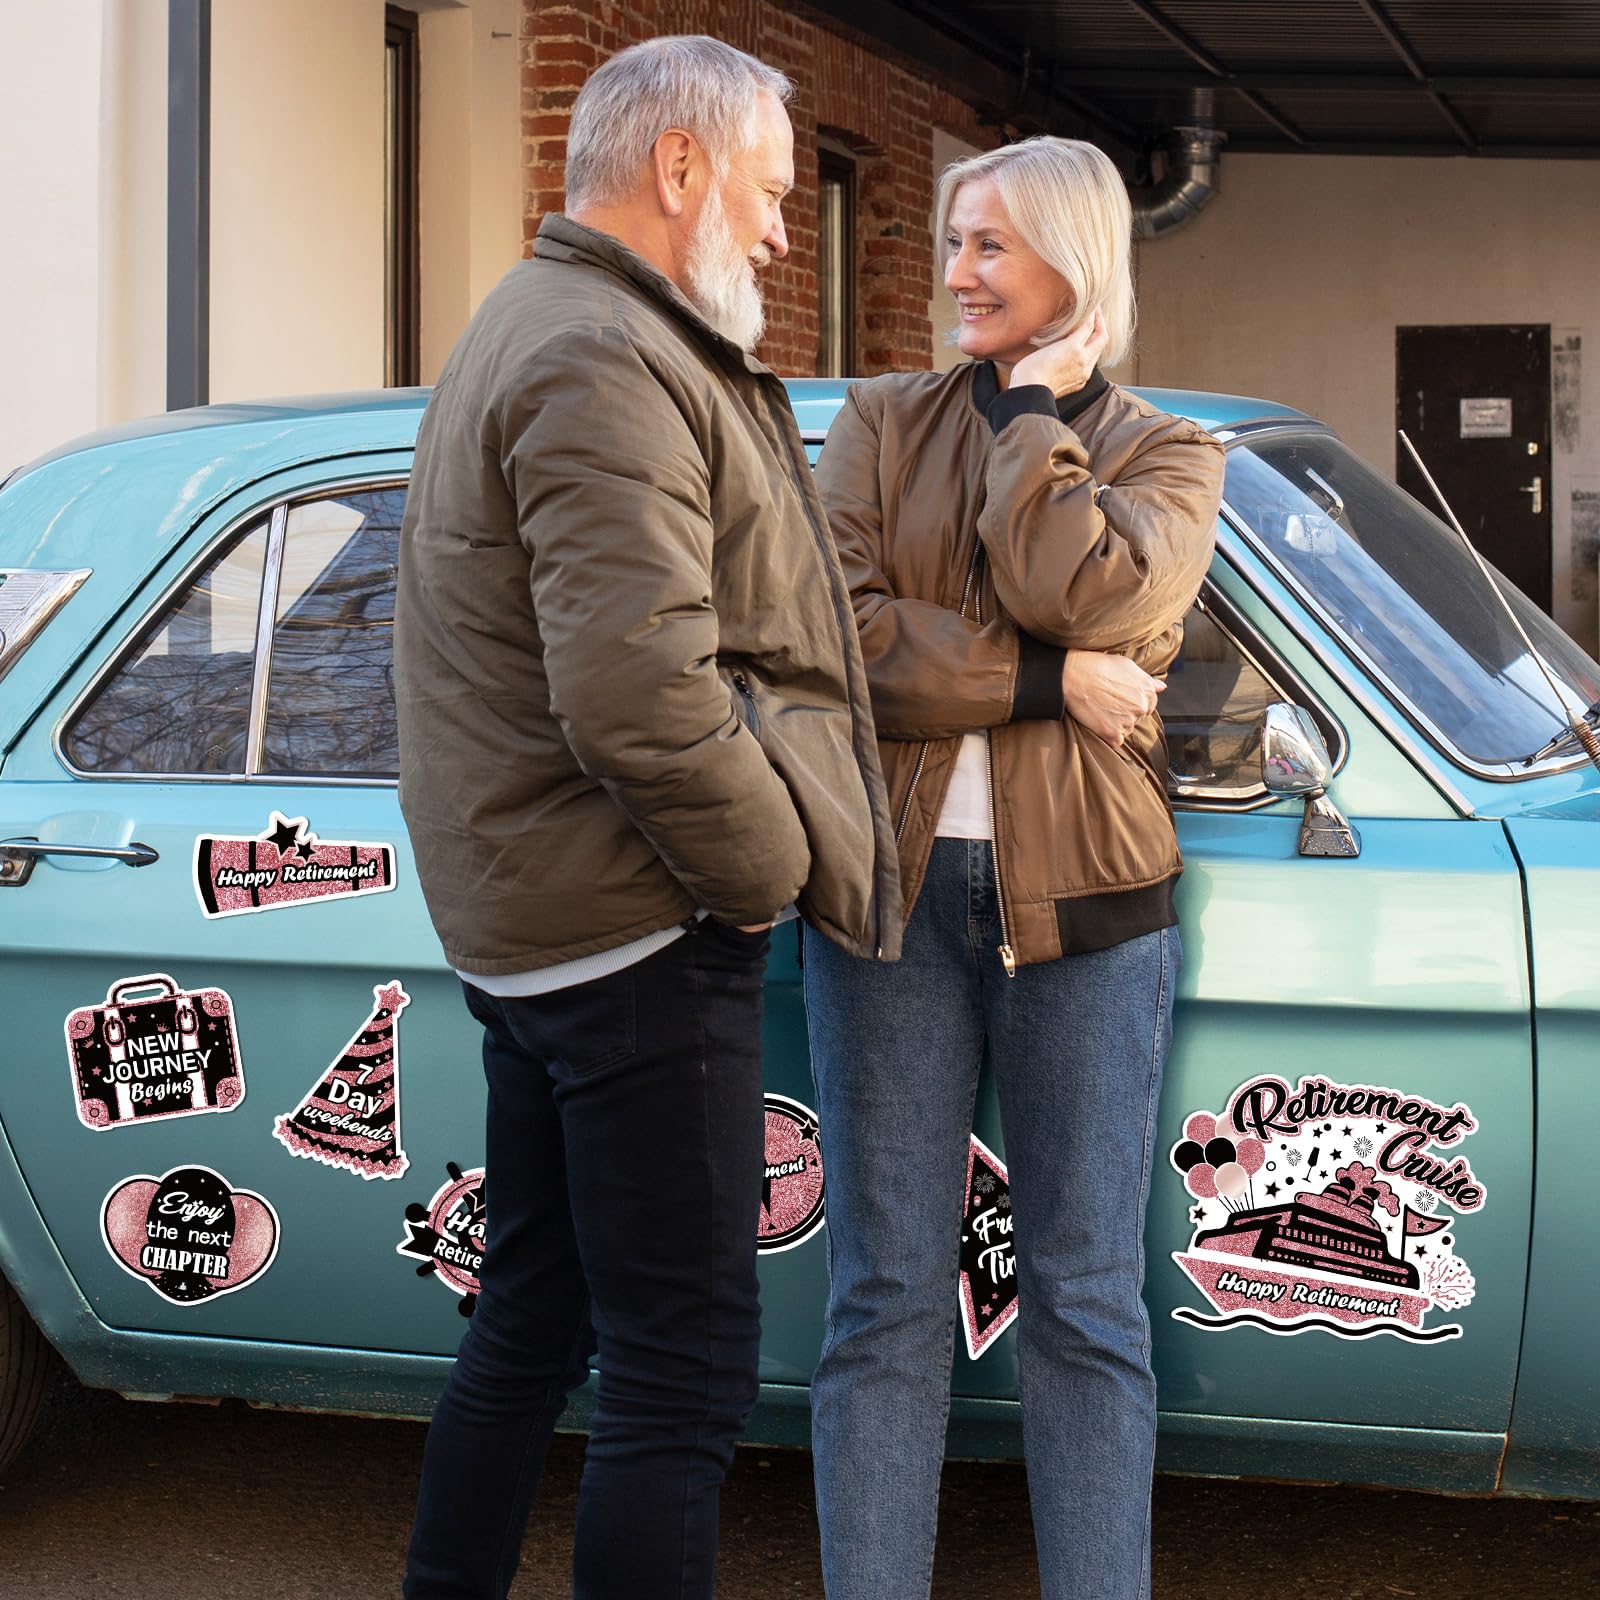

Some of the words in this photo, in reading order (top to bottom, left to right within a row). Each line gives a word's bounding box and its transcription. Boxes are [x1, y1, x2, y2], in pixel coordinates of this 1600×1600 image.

[218, 869, 276, 887] Happy
[284, 862, 376, 881] Retirement
[127, 1032, 180, 1057] NEW
[102, 1049, 212, 1083] JOURNEY
[358, 1063, 374, 1085] 7
[131, 1079, 193, 1102] Begins
[328, 1078, 383, 1118] Day
[303, 1106, 393, 1141] weekends
[1232, 1081, 1471, 1141] Retirement
[763, 1156, 805, 1178] ment
[1379, 1131, 1480, 1207] Cruise
[158, 1191, 225, 1225] Enjoy
[146, 1220, 178, 1240] the
[188, 1230, 232, 1247] next
[446, 1211, 486, 1244] Ha
[142, 1246, 229, 1277] CHAPTER
[1218, 1272, 1285, 1300] Happy
[1292, 1284, 1399, 1316] Retirement
